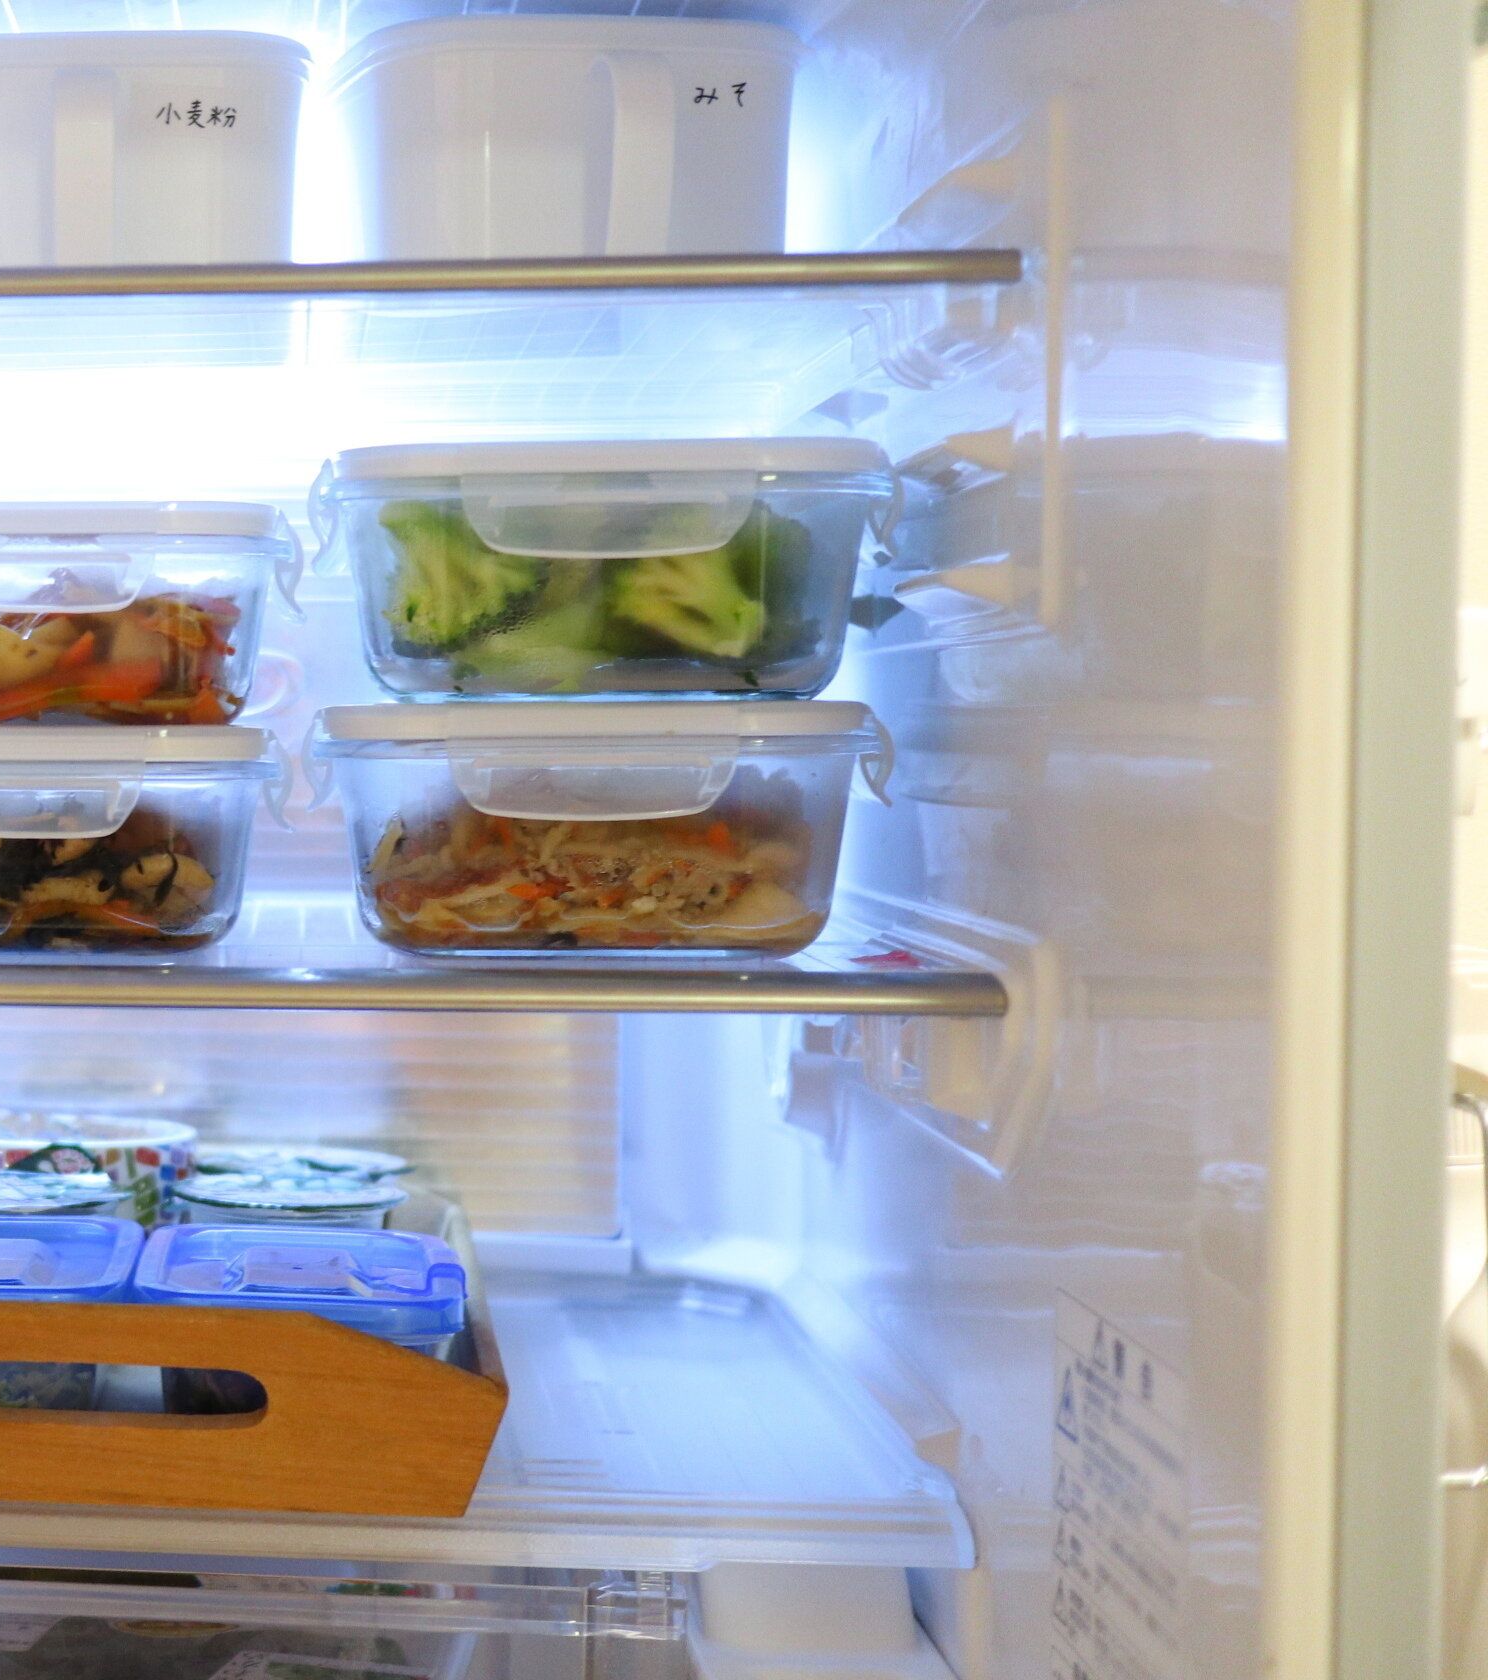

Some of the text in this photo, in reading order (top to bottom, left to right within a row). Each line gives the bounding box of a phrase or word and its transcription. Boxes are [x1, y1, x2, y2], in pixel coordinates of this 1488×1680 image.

[694, 82, 747, 107] みそ
[155, 100, 237, 128] 小麦粉
